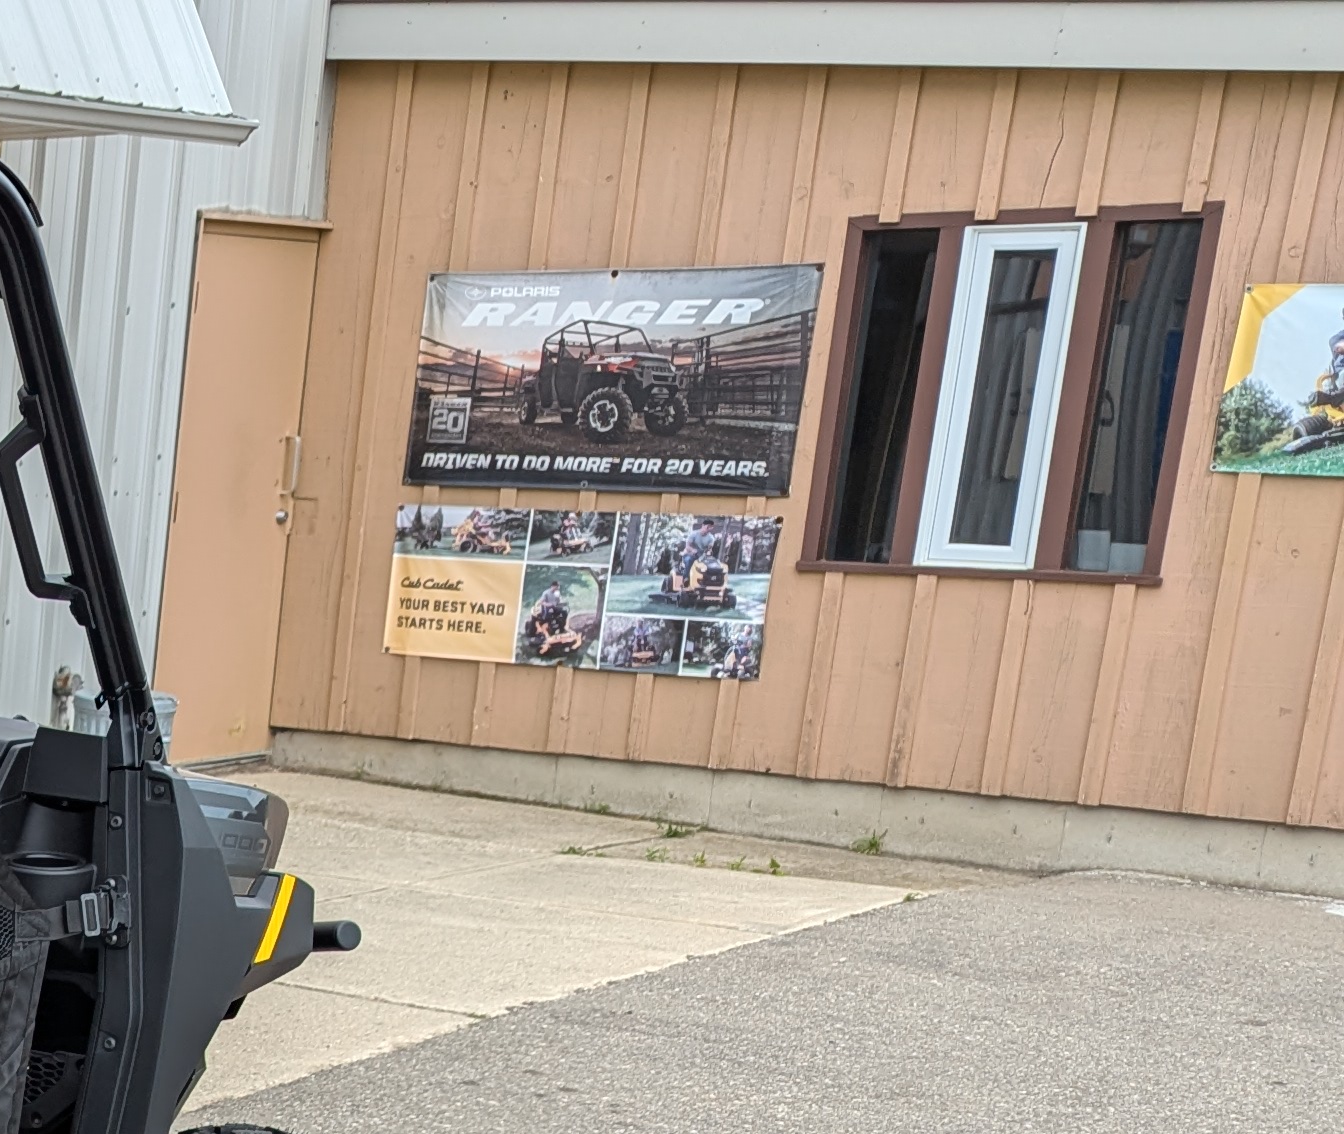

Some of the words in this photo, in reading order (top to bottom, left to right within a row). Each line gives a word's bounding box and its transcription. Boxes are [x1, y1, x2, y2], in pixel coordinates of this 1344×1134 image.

[490, 286, 561, 298] POLARIS
[461, 298, 765, 328] RANGER
[432, 408, 465, 433] 20
[420, 452, 492, 470] DRIVEN
[495, 454, 520, 471] TO
[522, 454, 551, 472] DO
[620, 457, 662, 474] FOR
[664, 458, 694, 475] 20
[699, 460, 769, 478] YEARS.
[401, 576, 421, 589] Cub
[399, 597, 430, 611] YOUR
[433, 599, 467, 613] BEST
[469, 602, 506, 616] YARD
[397, 615, 443, 631] STARTS
[447, 619, 486, 634] HERE.
